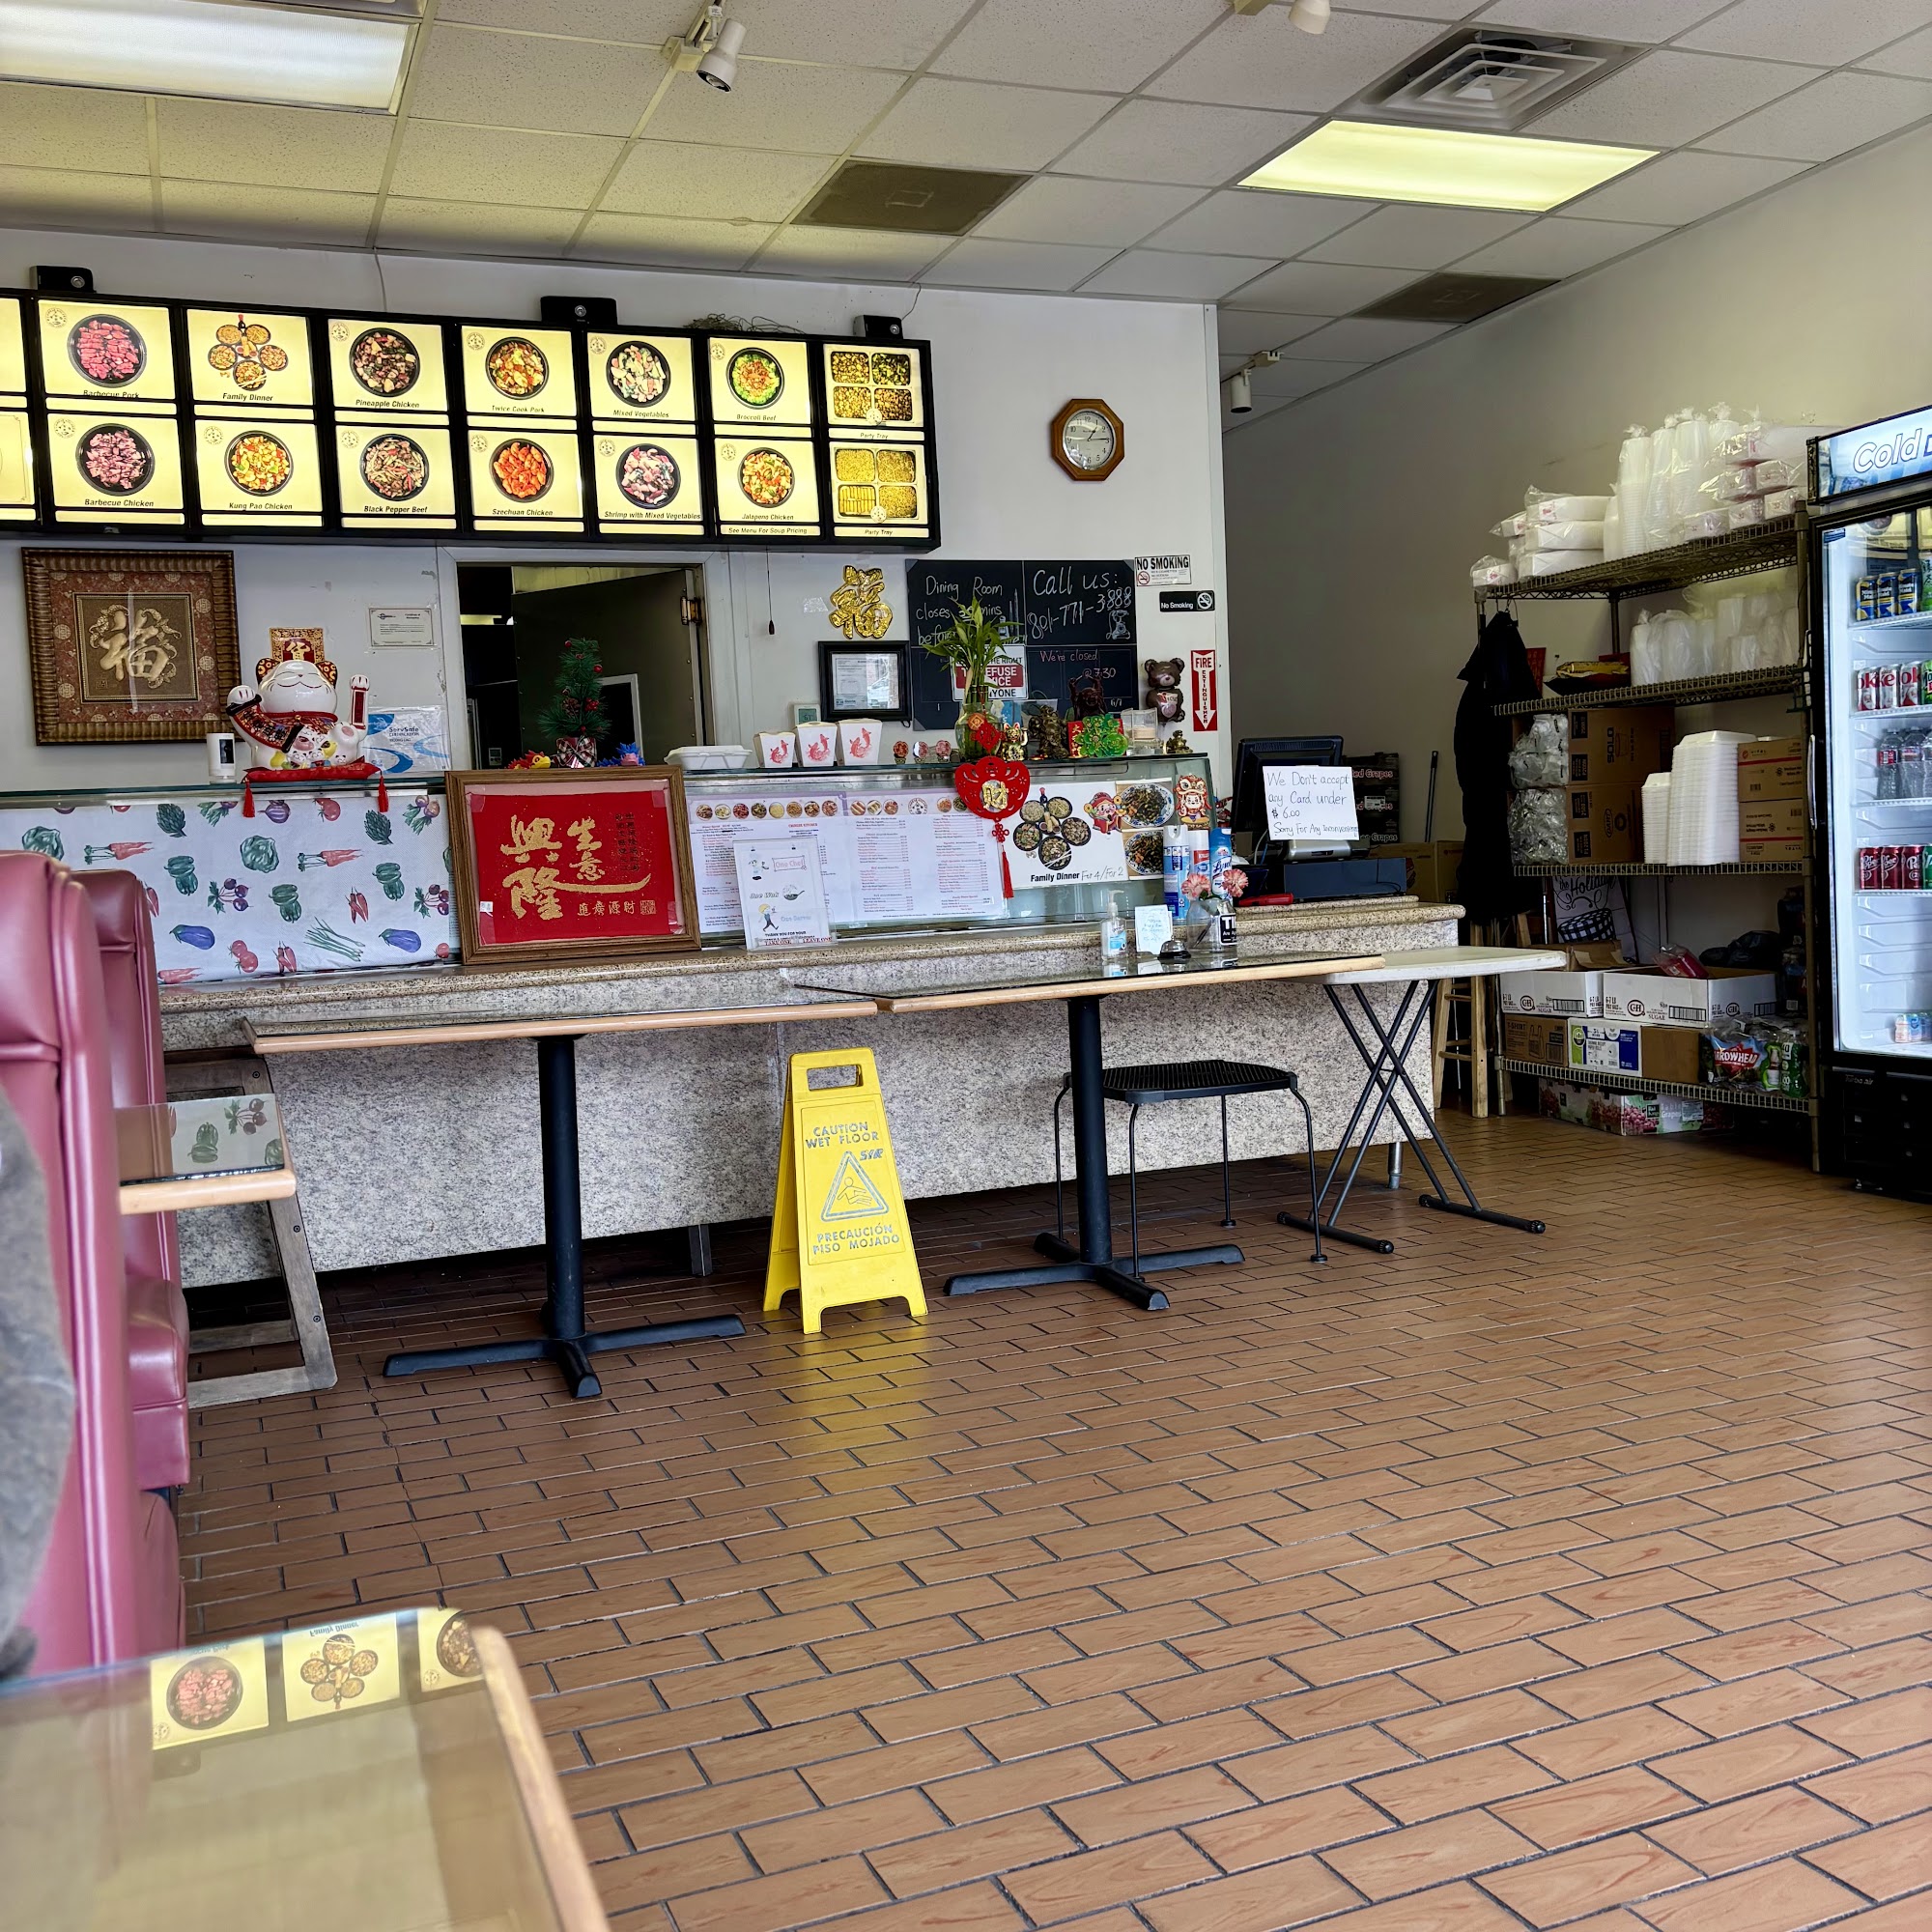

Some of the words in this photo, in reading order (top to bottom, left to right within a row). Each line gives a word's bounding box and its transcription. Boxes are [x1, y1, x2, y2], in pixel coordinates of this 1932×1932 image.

[222, 392, 247, 401] Family
[249, 393, 273, 402] Dinner
[355, 399, 390, 408] Pineapple
[1853, 428, 1922, 473] Cold
[1137, 558, 1149, 571] NO
[1151, 556, 1189, 569] SMOKING
[926, 575, 959, 602] Dining
[973, 577, 1003, 597] Room
[1033, 566, 1073, 596] Call
[1083, 572, 1118, 589] us:
[916, 602, 951, 620] closes
[1040, 650, 1065, 663] We're
[1070, 650, 1098, 663] closed
[1195, 658, 1212, 668] FIRE
[985, 667, 1017, 676] EFUSE
[1267, 771, 1287, 786] We
[1292, 771, 1317, 785] Don't
[1321, 774, 1350, 790] accept
[1268, 794, 1283, 807] any
[1291, 790, 1311, 804] Card
[1317, 790, 1348, 805] under
[1283, 808, 1300, 818] 6.00
[1274, 822, 1293, 837] Sorry
[1296, 823, 1307, 833] For
[1310, 823, 1321, 835] Any
[1031, 873, 1054, 883] Family
[812, 1122, 869, 1138] CAUTION
[806, 1137, 831, 1150] WET
[838, 1130, 880, 1145] FLOOR
[816, 1222, 894, 1243] PRECAUCIÓN
[812, 1241, 841, 1256] PISO
[848, 1234, 900, 1250] MOJADO
